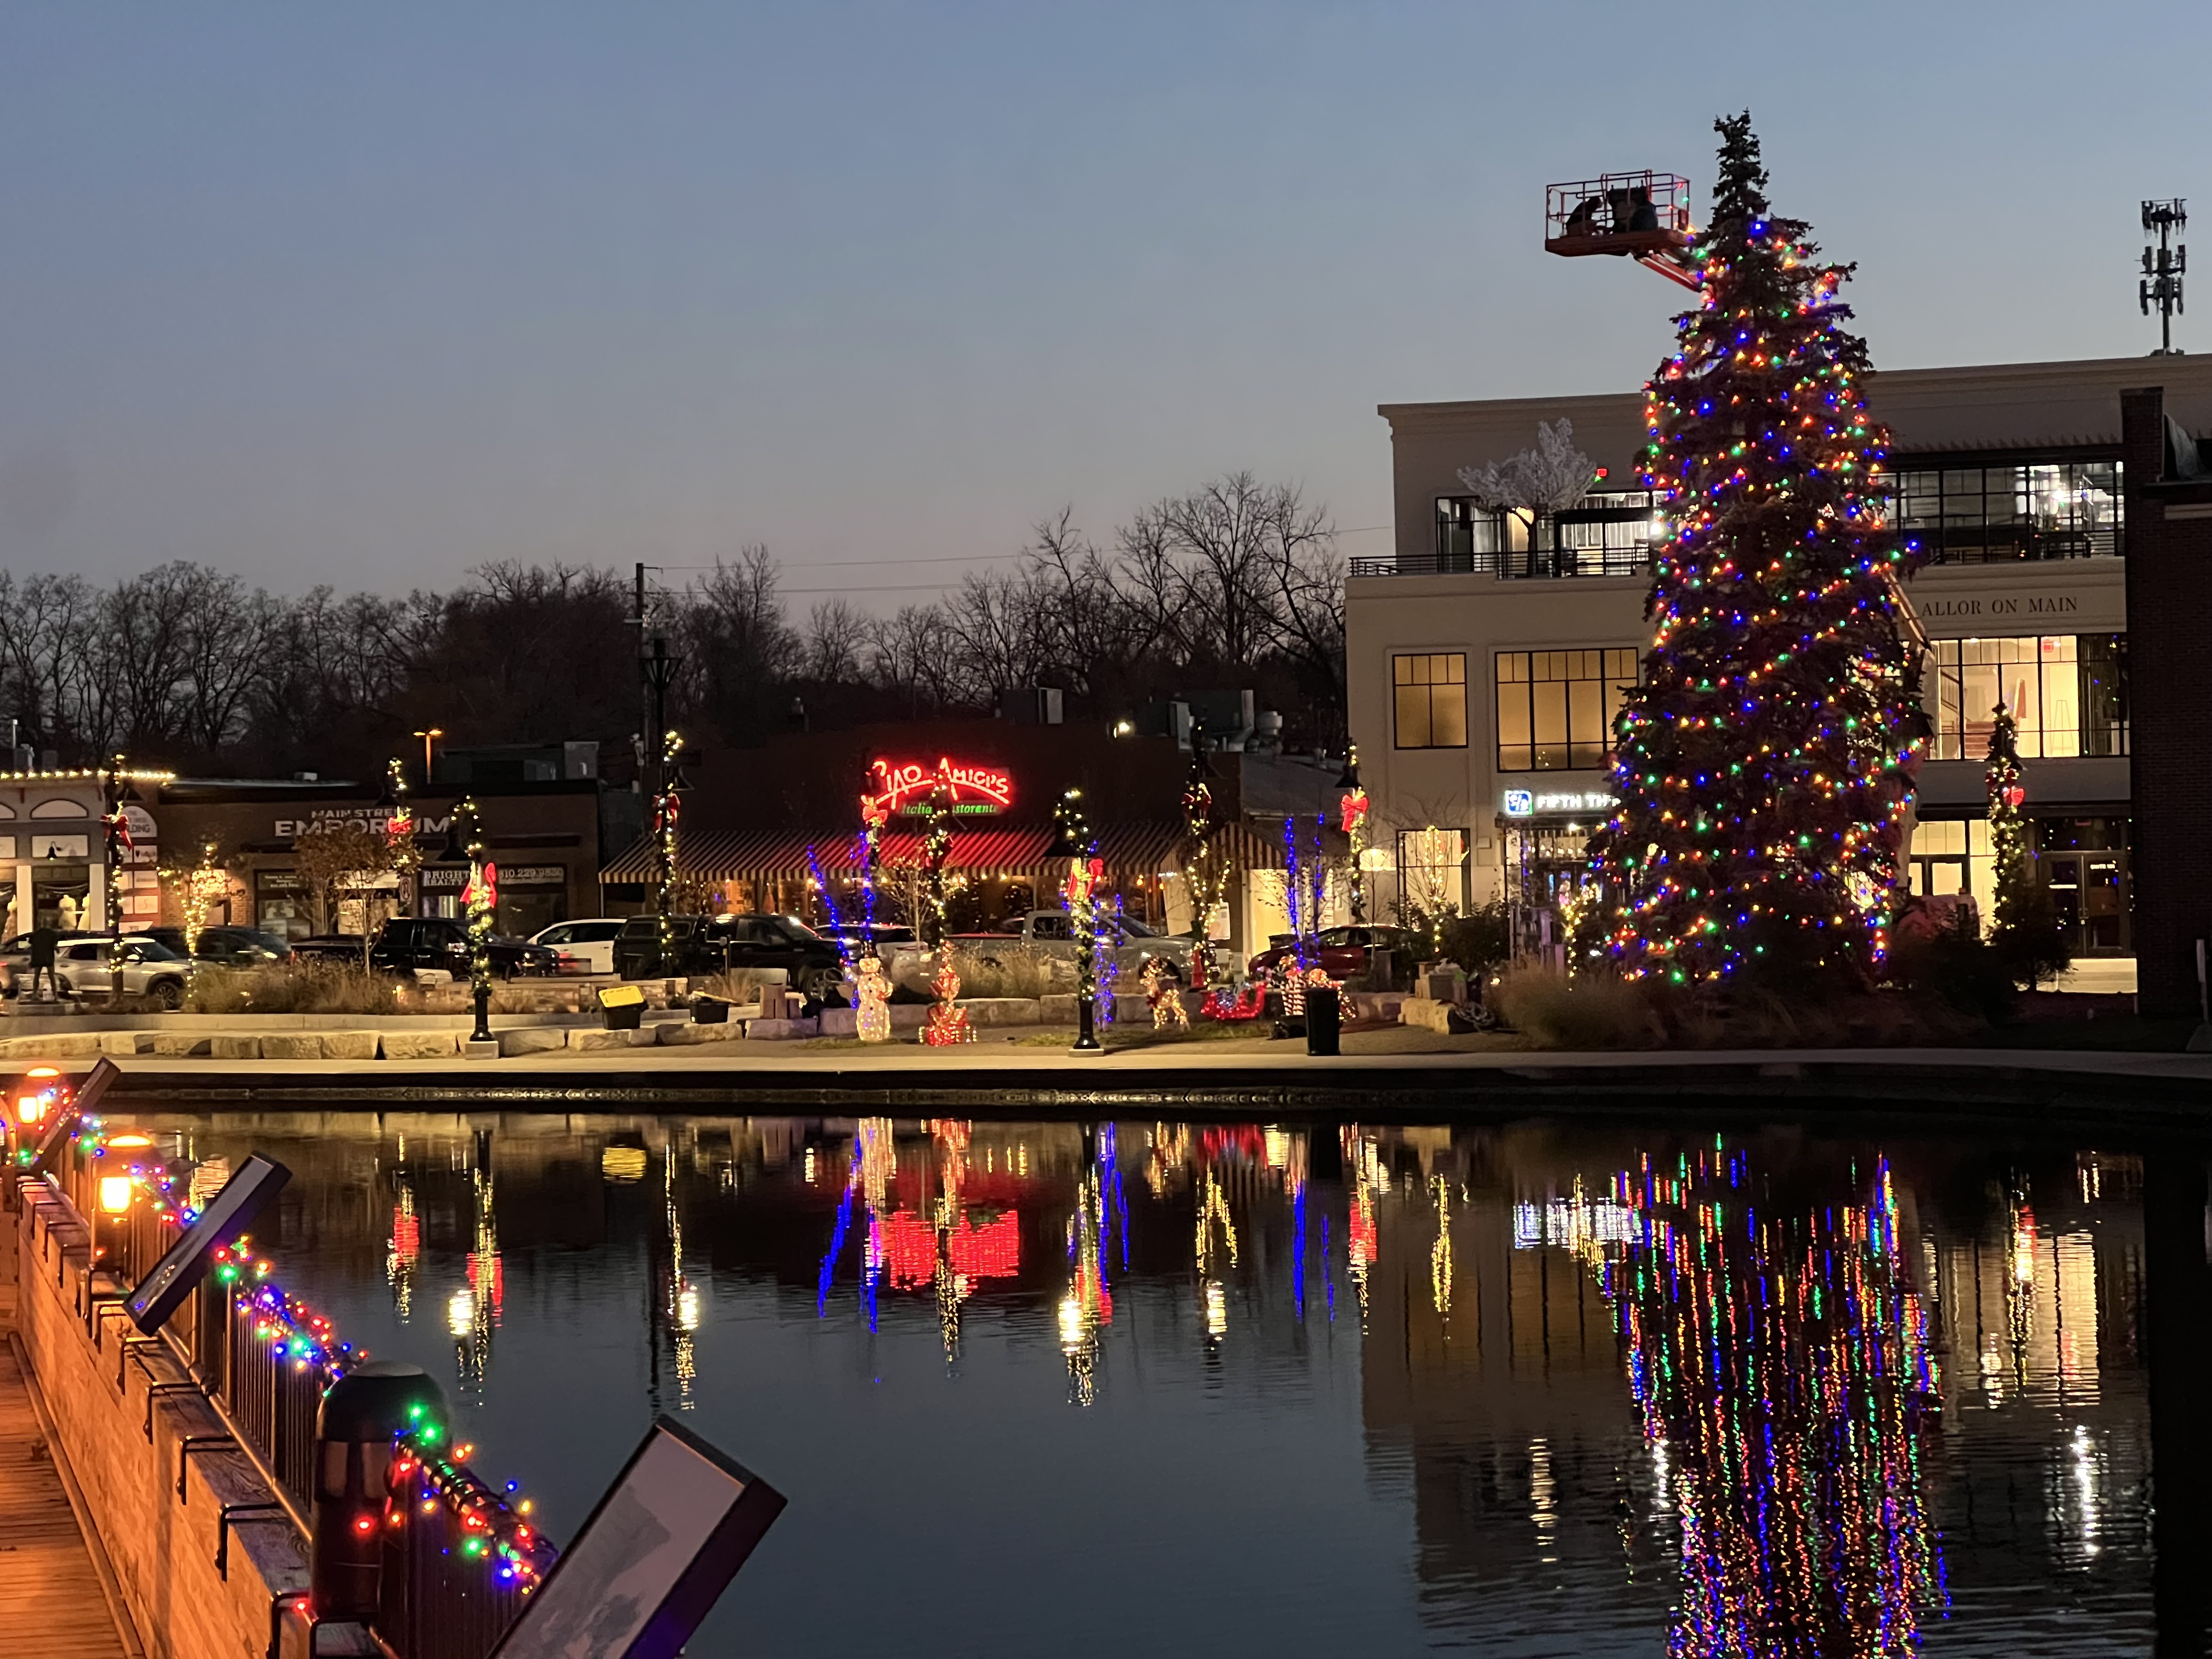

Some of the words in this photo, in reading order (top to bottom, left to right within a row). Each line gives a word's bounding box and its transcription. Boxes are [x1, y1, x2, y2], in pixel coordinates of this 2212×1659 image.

[1922, 600, 1981, 617] ALLOR
[1991, 599, 2018, 613] ON
[2028, 596, 2078, 613] MAIN
[1537, 794, 1582, 808] FIFTH
[311, 809, 351, 818] MAIN
[356, 808, 402, 818] STRE
[901, 802, 933, 814] Italia
[275, 816, 449, 837] EMPORUM
[422, 878, 463, 887] REALTY
